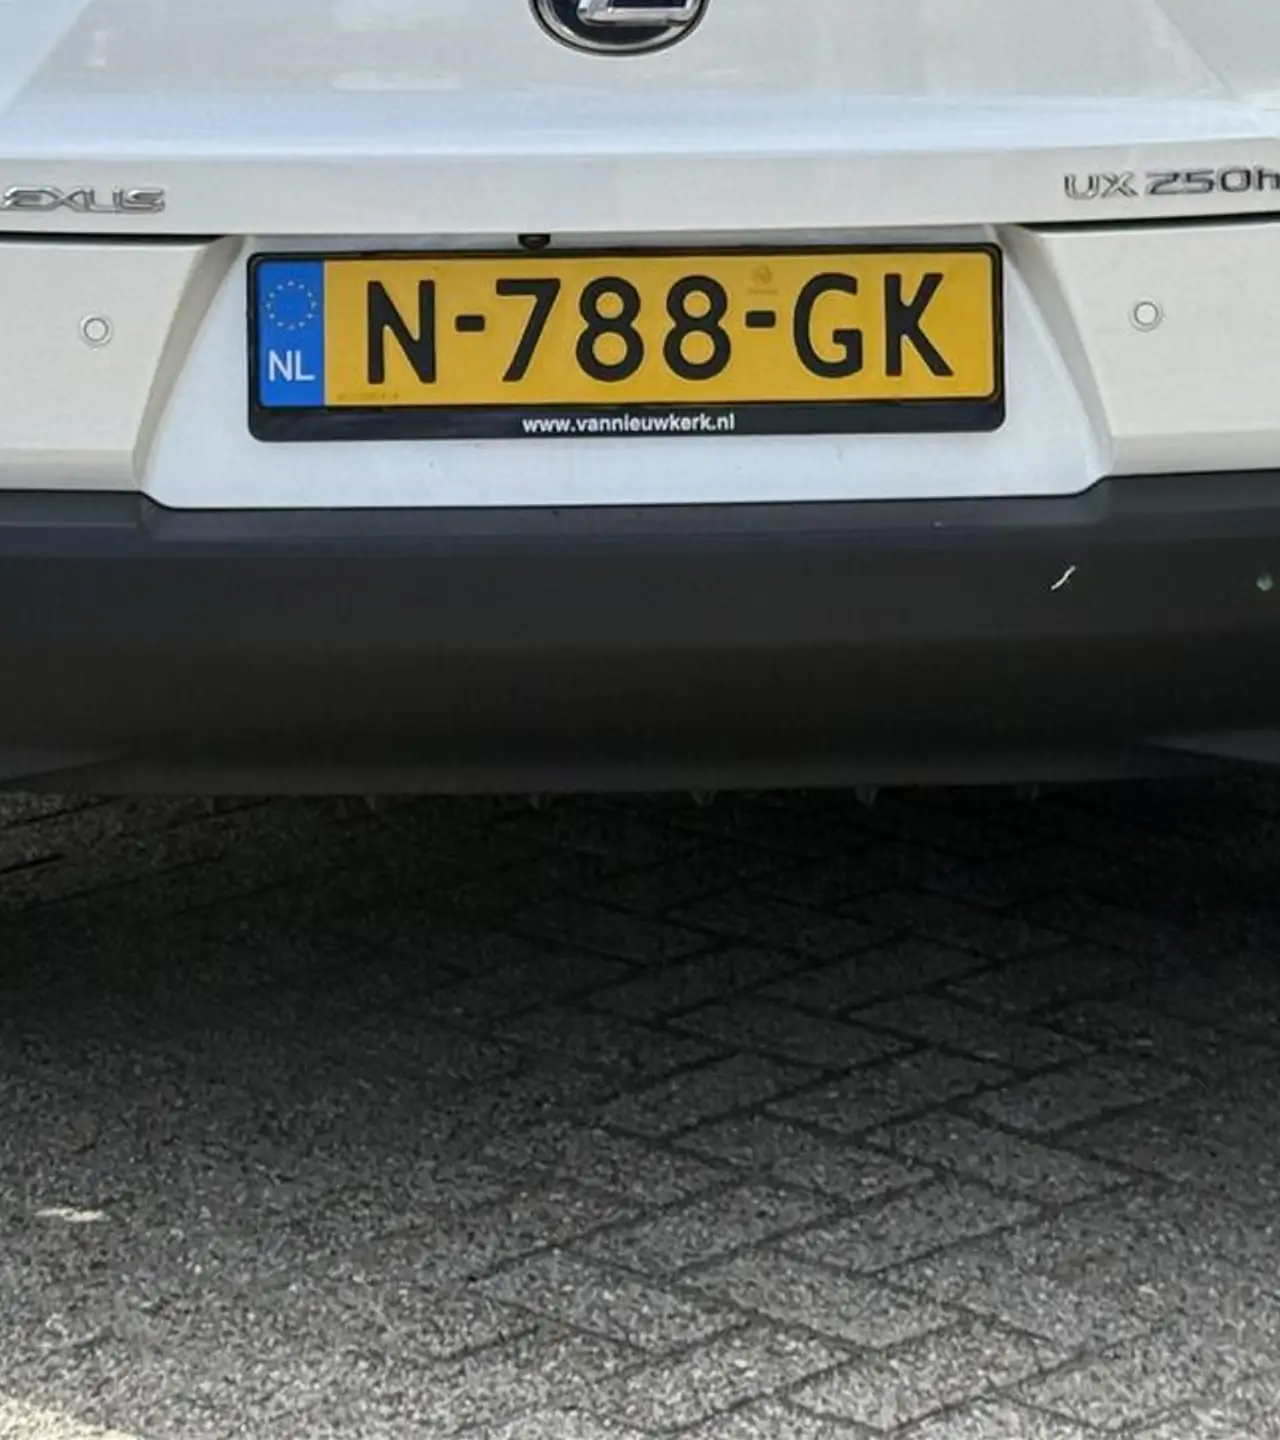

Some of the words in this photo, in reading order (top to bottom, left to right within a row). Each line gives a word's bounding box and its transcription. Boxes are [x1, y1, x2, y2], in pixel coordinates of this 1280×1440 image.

[1062, 171, 1139, 200] UX
[367, 272, 956, 388] N-788-GK
[266, 351, 316, 384] NL
[521, 412, 736, 435] www.vannieuwkerk.nl
